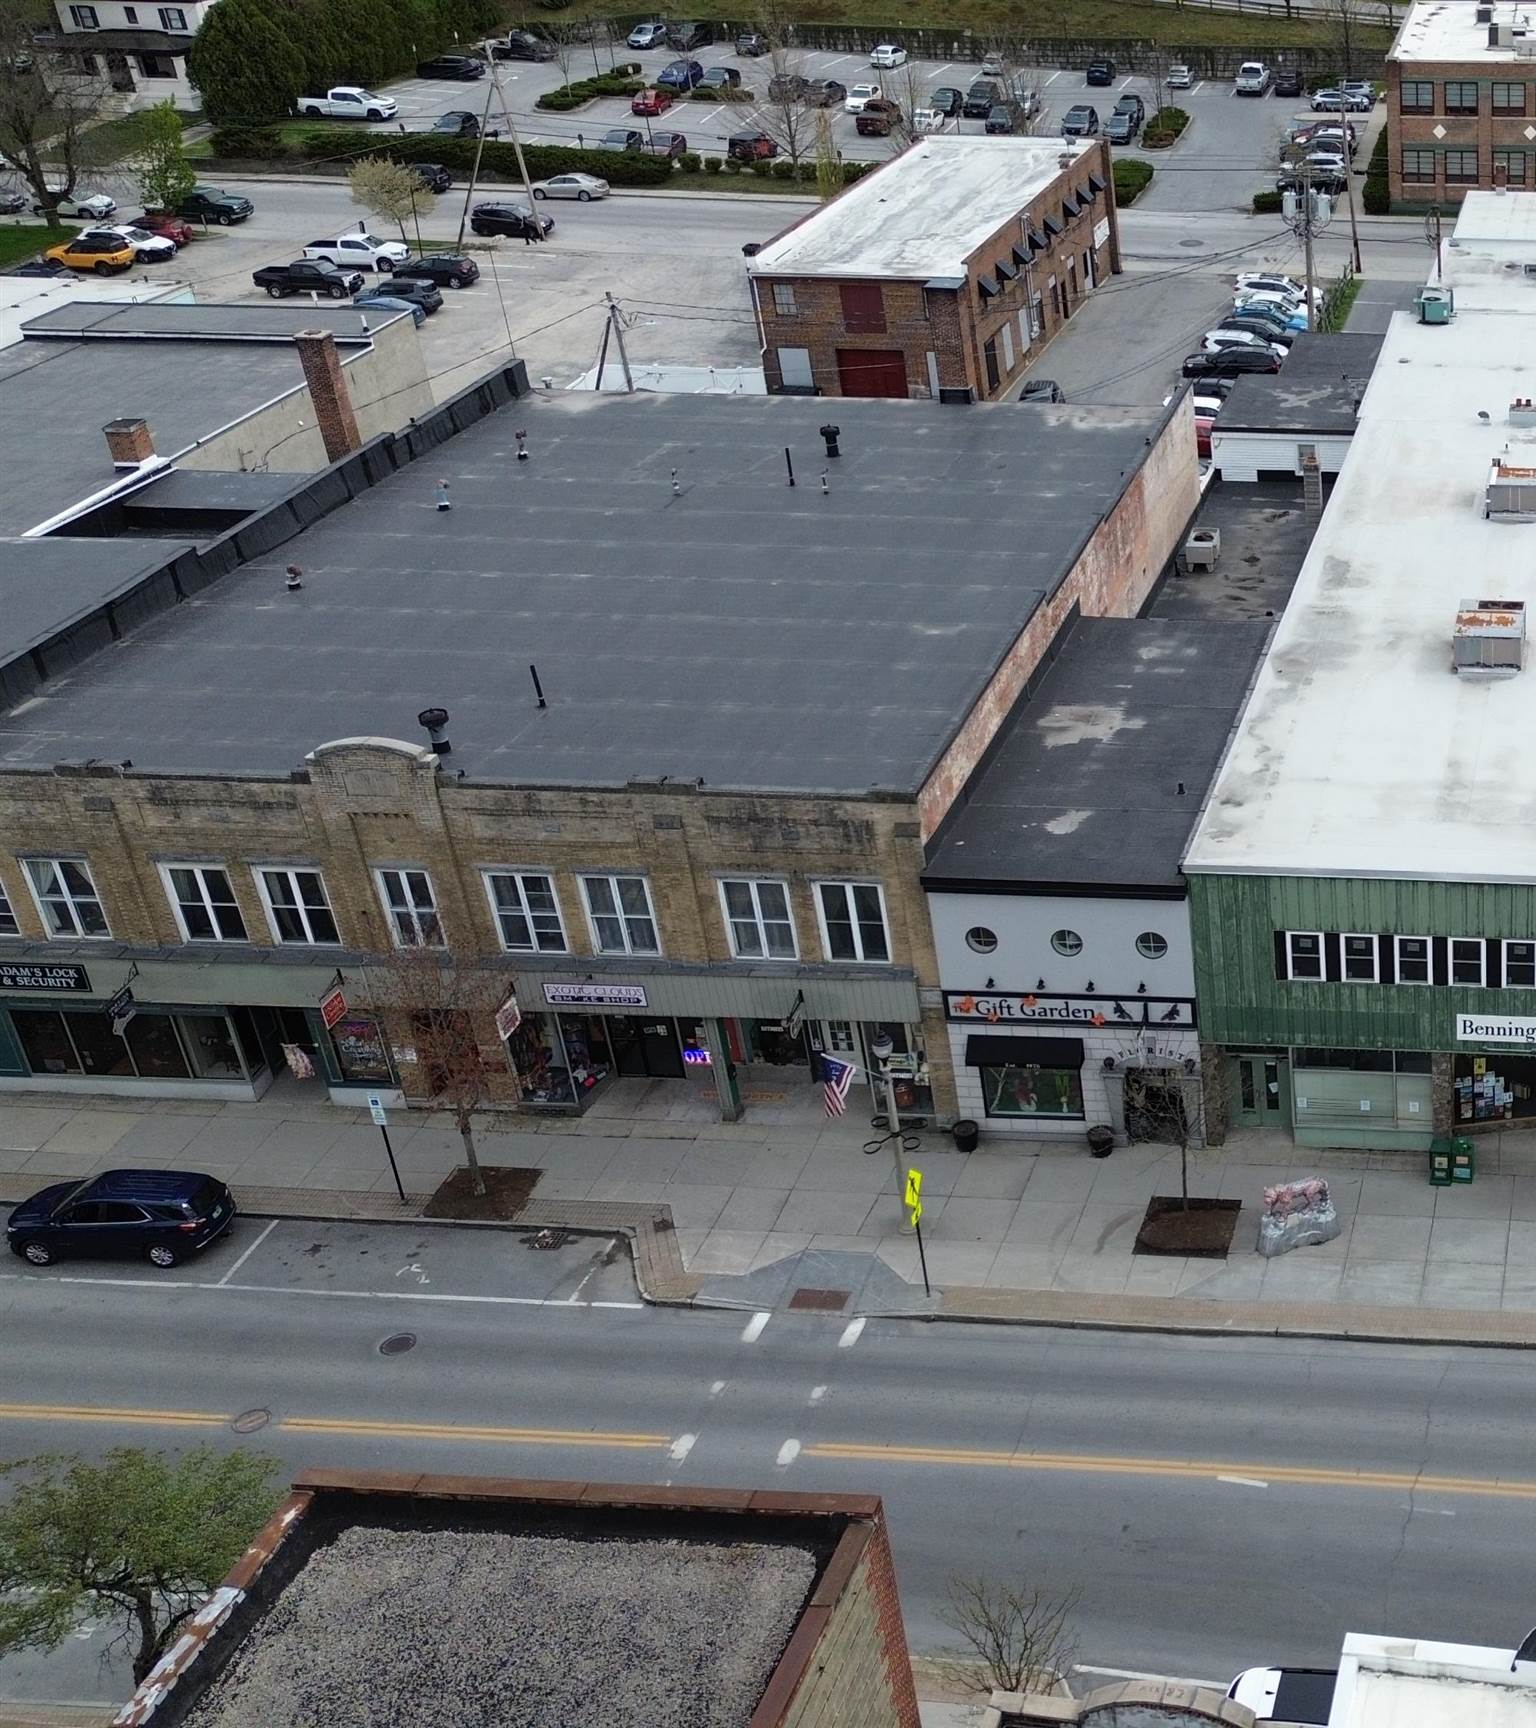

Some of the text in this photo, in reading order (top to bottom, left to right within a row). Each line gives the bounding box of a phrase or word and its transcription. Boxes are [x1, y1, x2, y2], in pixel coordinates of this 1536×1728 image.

[45, 967, 79, 978] LOCK
[2, 976, 76, 988] & SECURITY
[546, 985, 644, 997] EXOTIC CLOUDS
[975, 999, 1016, 1017] Gift
[1020, 1001, 1095, 1019] Garden
